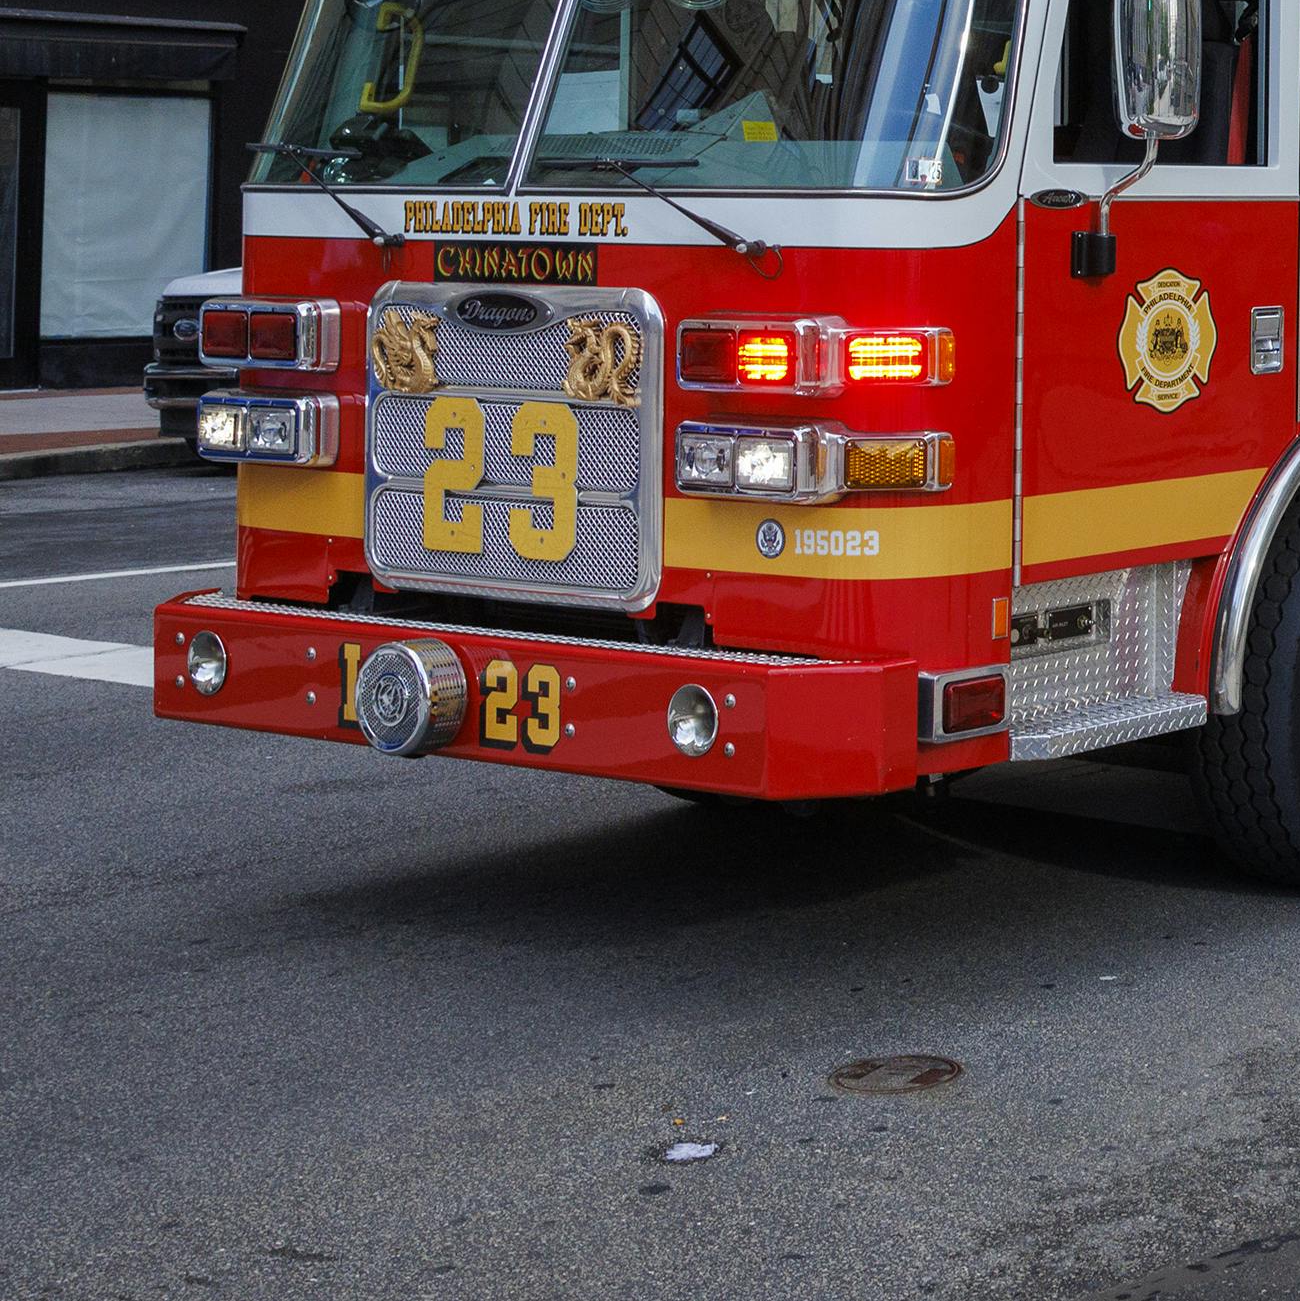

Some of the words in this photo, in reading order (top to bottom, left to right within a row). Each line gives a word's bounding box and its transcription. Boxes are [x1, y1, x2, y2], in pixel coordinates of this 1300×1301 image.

[404, 201, 521, 234] PHILADELPHIA
[529, 203, 569, 235] FIRE
[579, 203, 629, 236] DEPT.
[437, 246, 593, 281] CHINATOWN
[462, 302, 536, 327] Dragons
[1144, 292, 1192, 314] PHILADELPHIA
[1141, 366, 1153, 384] FIRE
[1155, 364, 1194, 389] DEPARTMENT
[423, 396, 579, 563] 23
[794, 528, 880, 556] 195023
[480, 659, 561, 755] 23
